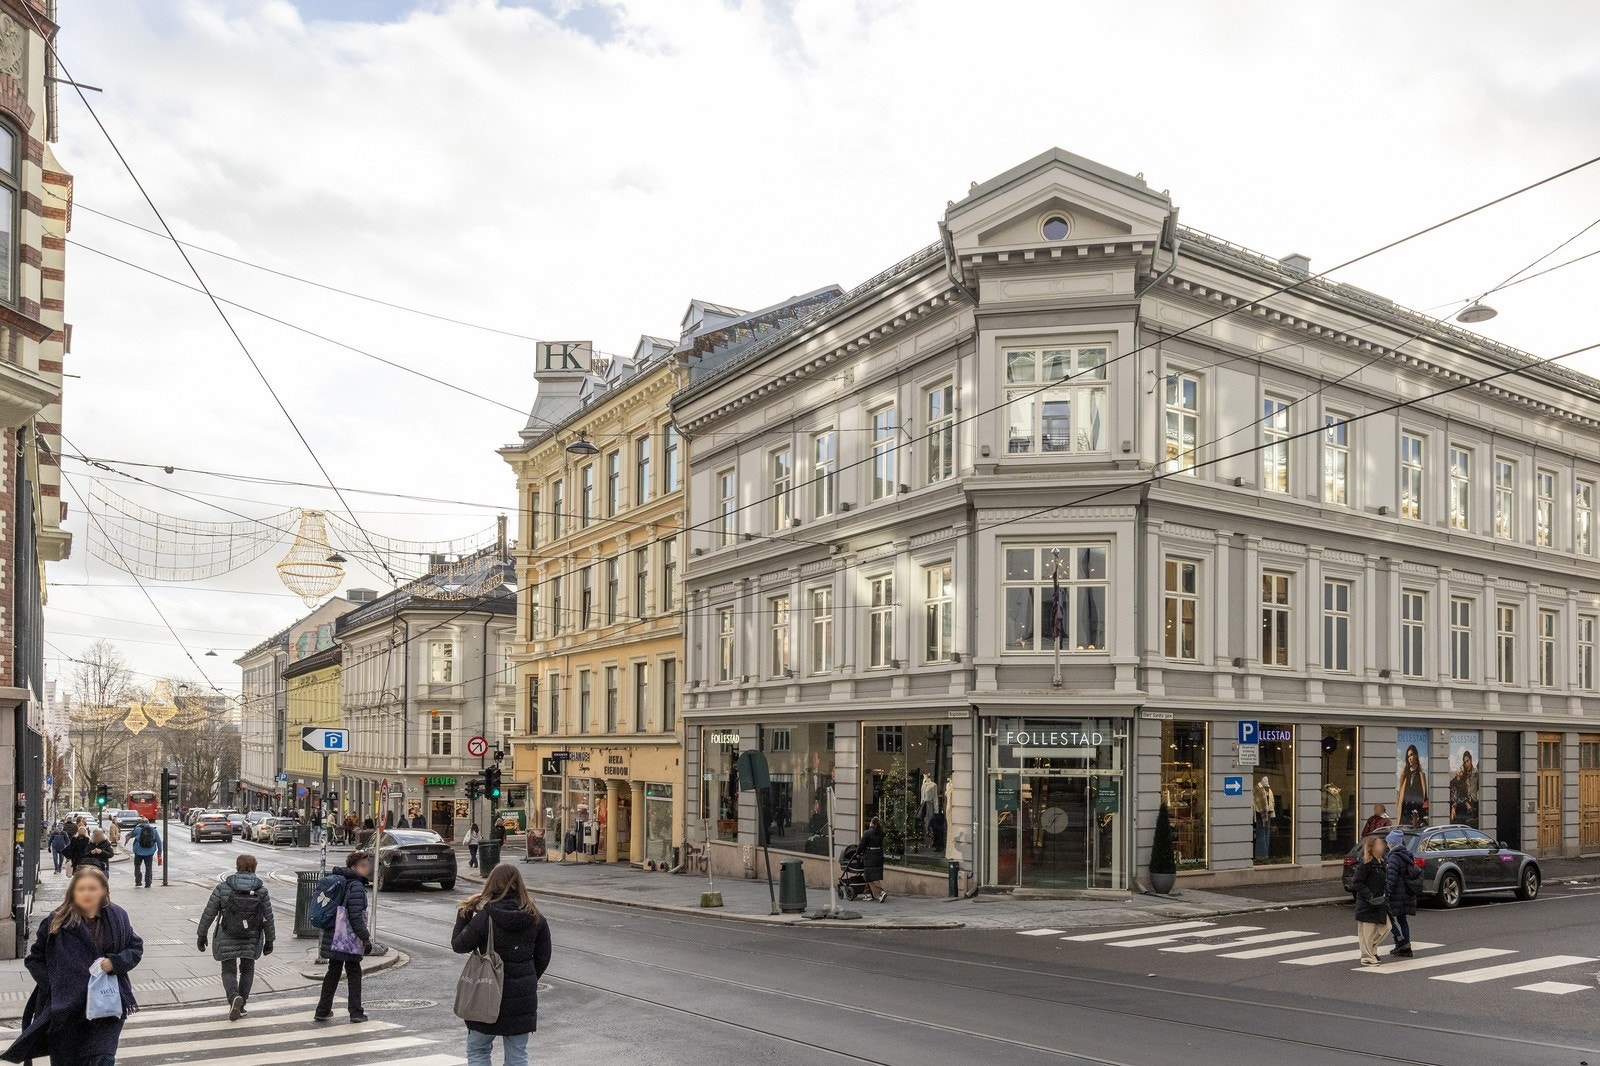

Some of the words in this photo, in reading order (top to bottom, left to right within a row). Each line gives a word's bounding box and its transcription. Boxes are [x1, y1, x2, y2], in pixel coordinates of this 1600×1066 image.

[544, 343, 582, 369] HK
[710, 732, 740, 744] FOLLESTAD
[1006, 731, 1103, 746] FOLLESTAD
[1243, 723, 1254, 742] P
[1259, 730, 1291, 740] LLESTAD
[1397, 733, 1427, 743] OLLESTAD
[1450, 735, 1477, 744] OLLESTAD
[547, 761, 557, 773] K
